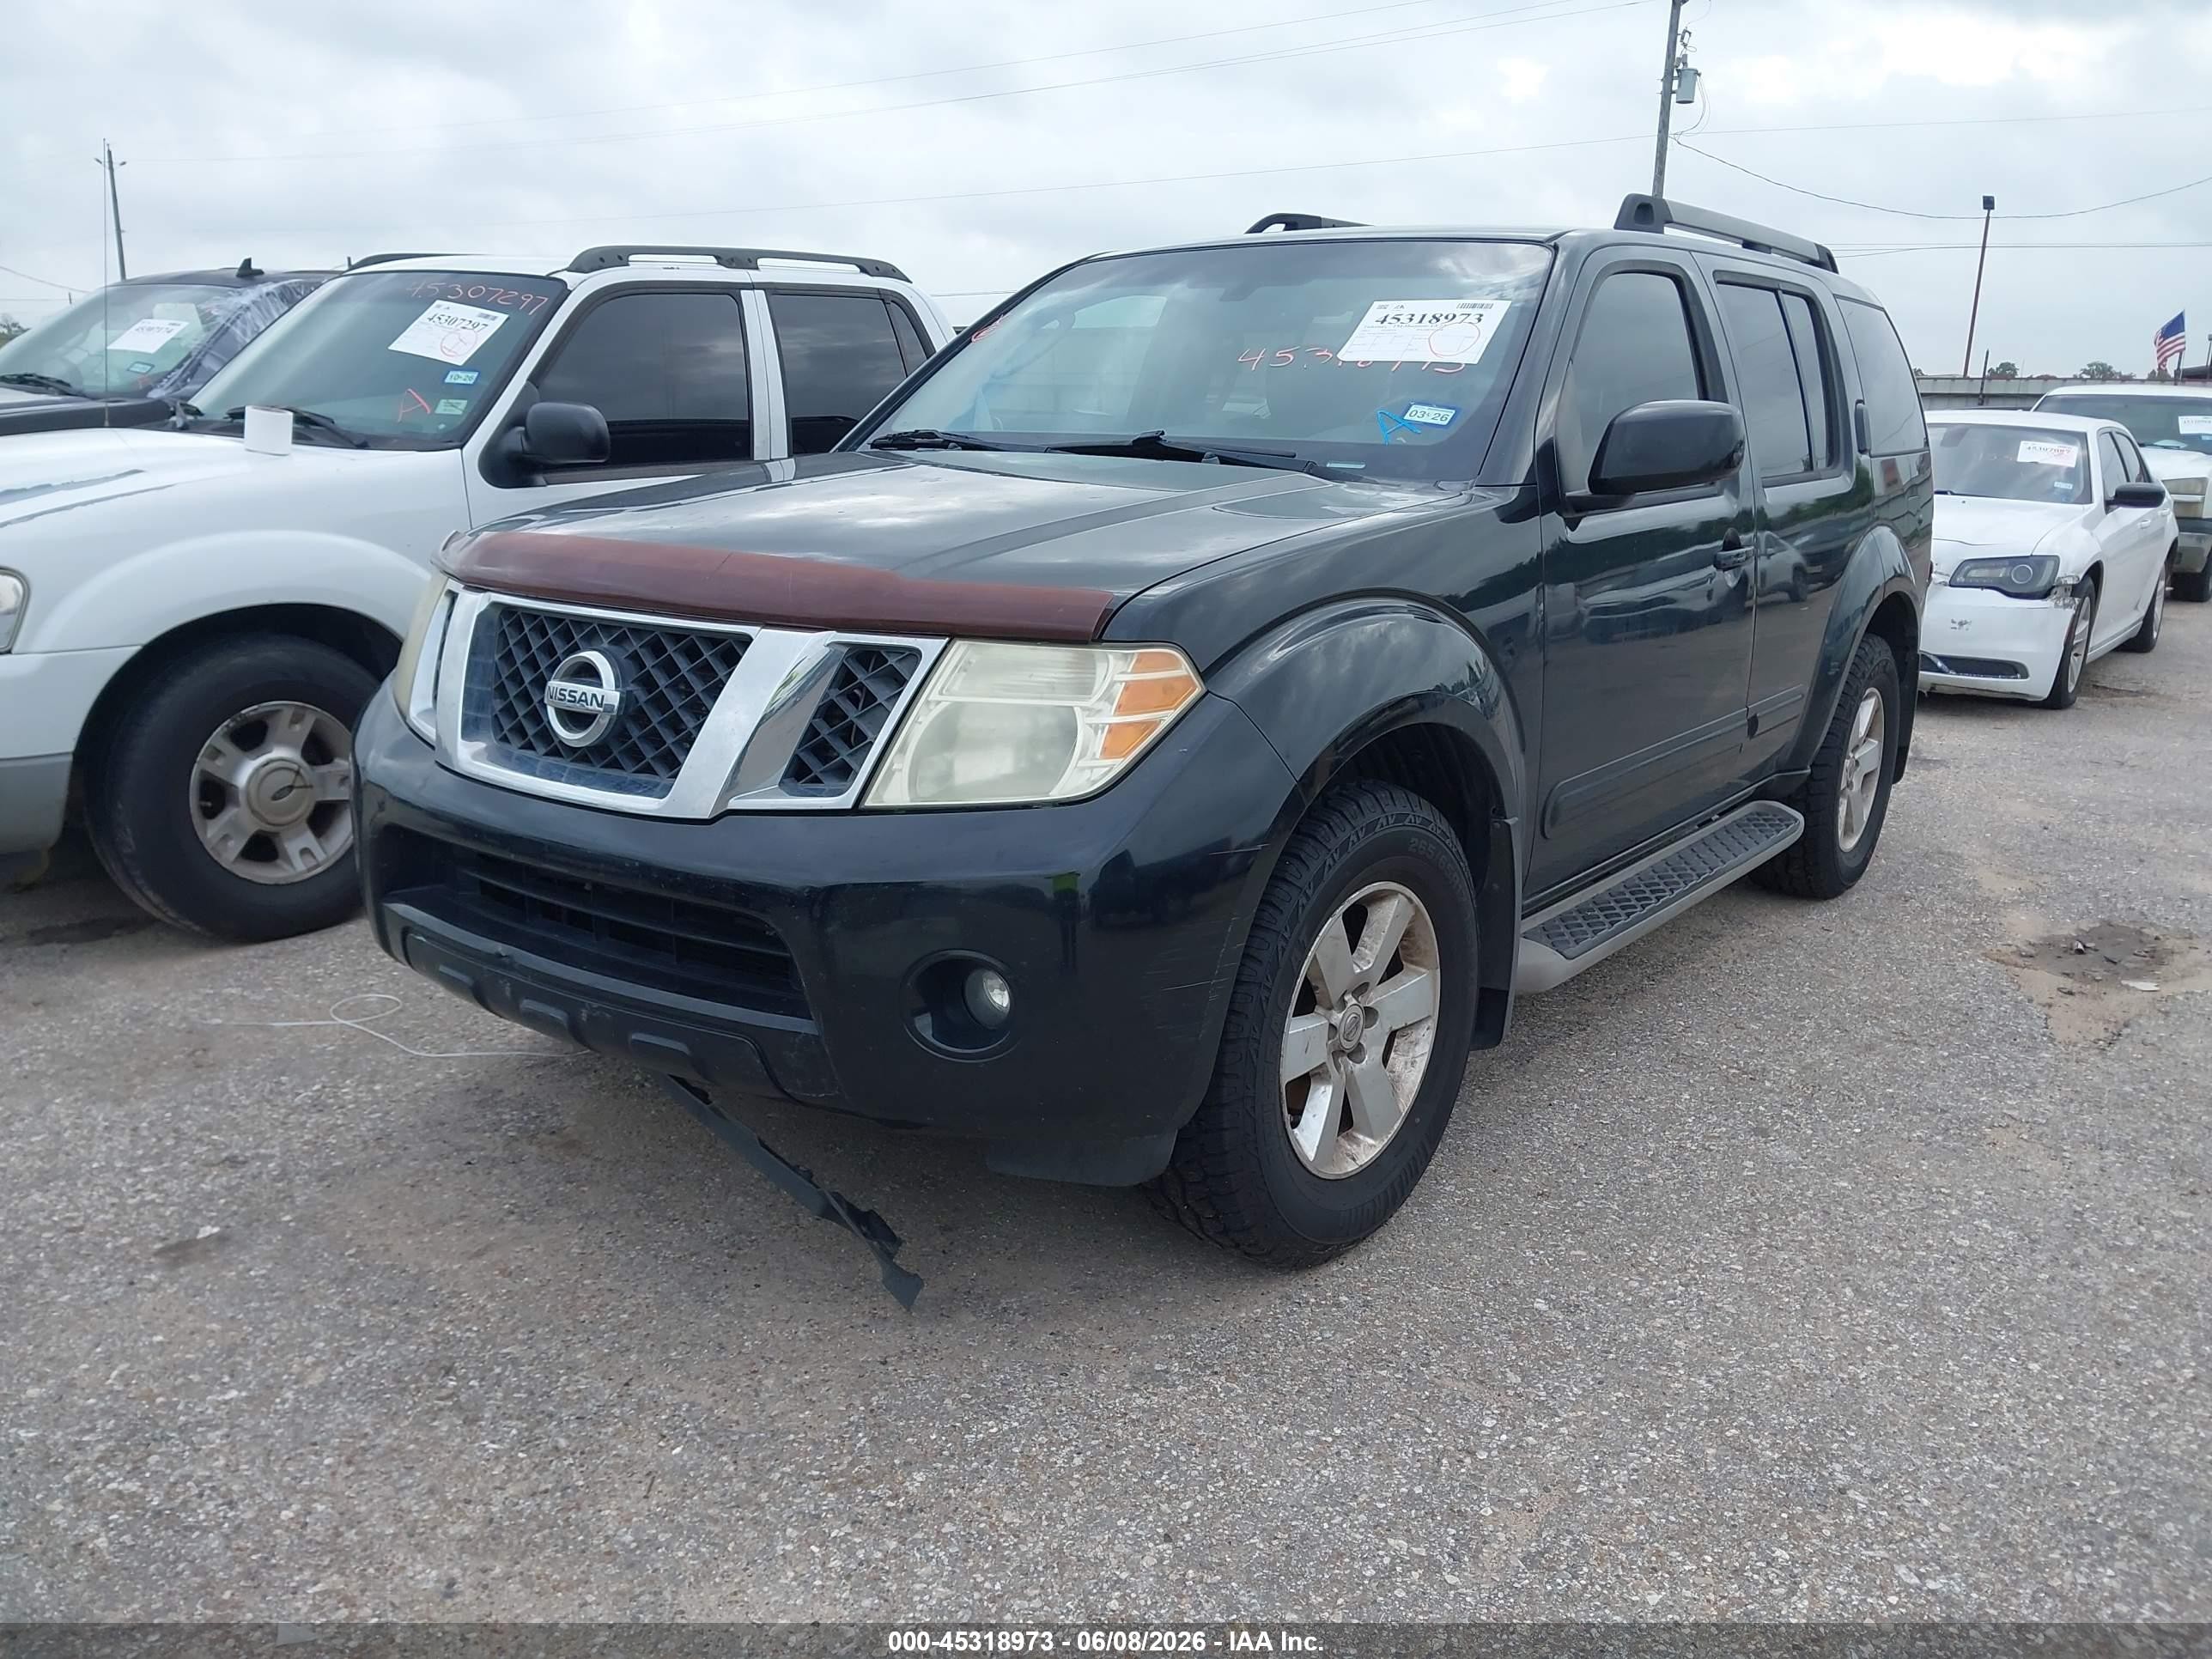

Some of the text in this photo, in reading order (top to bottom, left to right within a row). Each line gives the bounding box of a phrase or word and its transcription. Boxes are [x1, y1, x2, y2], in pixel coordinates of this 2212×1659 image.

[427, 312, 489, 332] 45307297
[1374, 312, 1485, 325] 45318973
[547, 685, 605, 708] NISSAN
